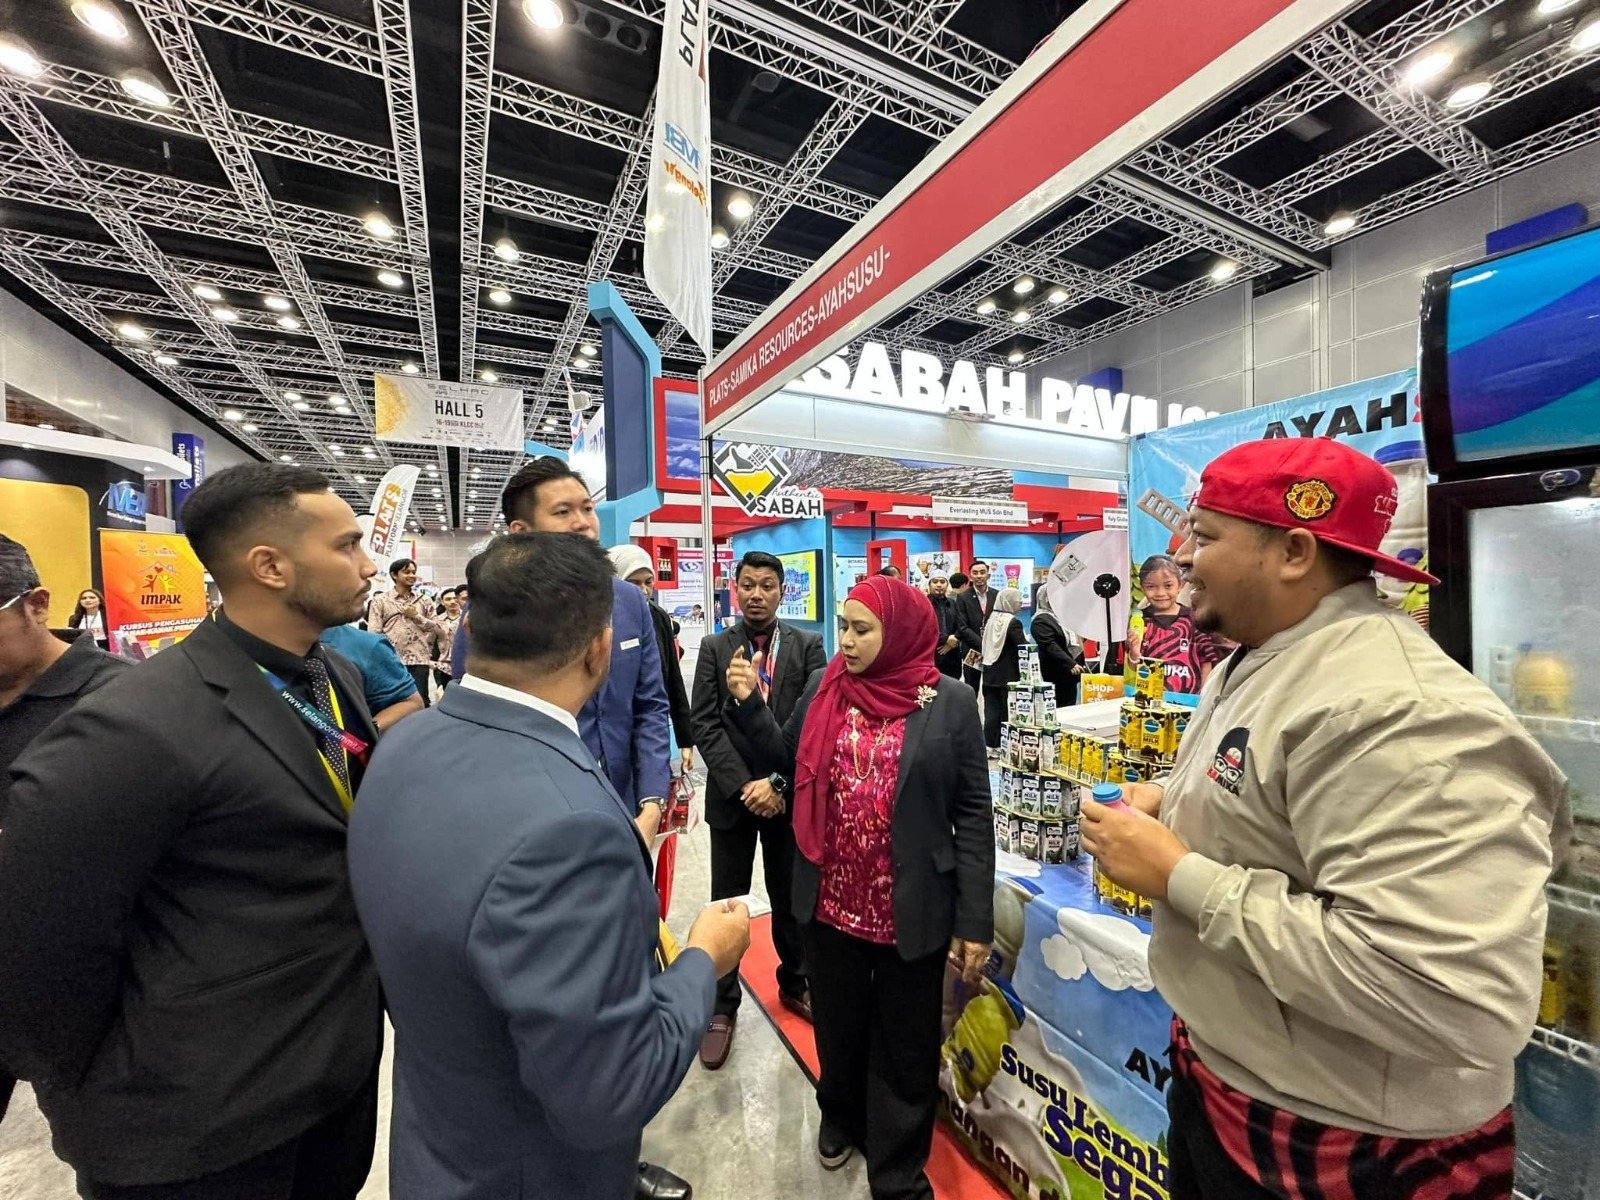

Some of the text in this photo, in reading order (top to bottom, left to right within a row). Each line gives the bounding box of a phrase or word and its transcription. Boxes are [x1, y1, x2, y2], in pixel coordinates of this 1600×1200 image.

[709, 245, 891, 408] PLATS-SAMIKA RESOURCES-AYAHSUSU-
[787, 341, 1027, 419] SABAH
[435, 399, 483, 418] HALL 5
[771, 486, 821, 498] Authentic
[756, 498, 821, 516] SABAH
[119, 621, 153, 631] KURSUS
[1085, 684, 1114, 693] SHOP
[1001, 1043, 1068, 1113] Susu
[943, 1092, 1030, 1194] angan
